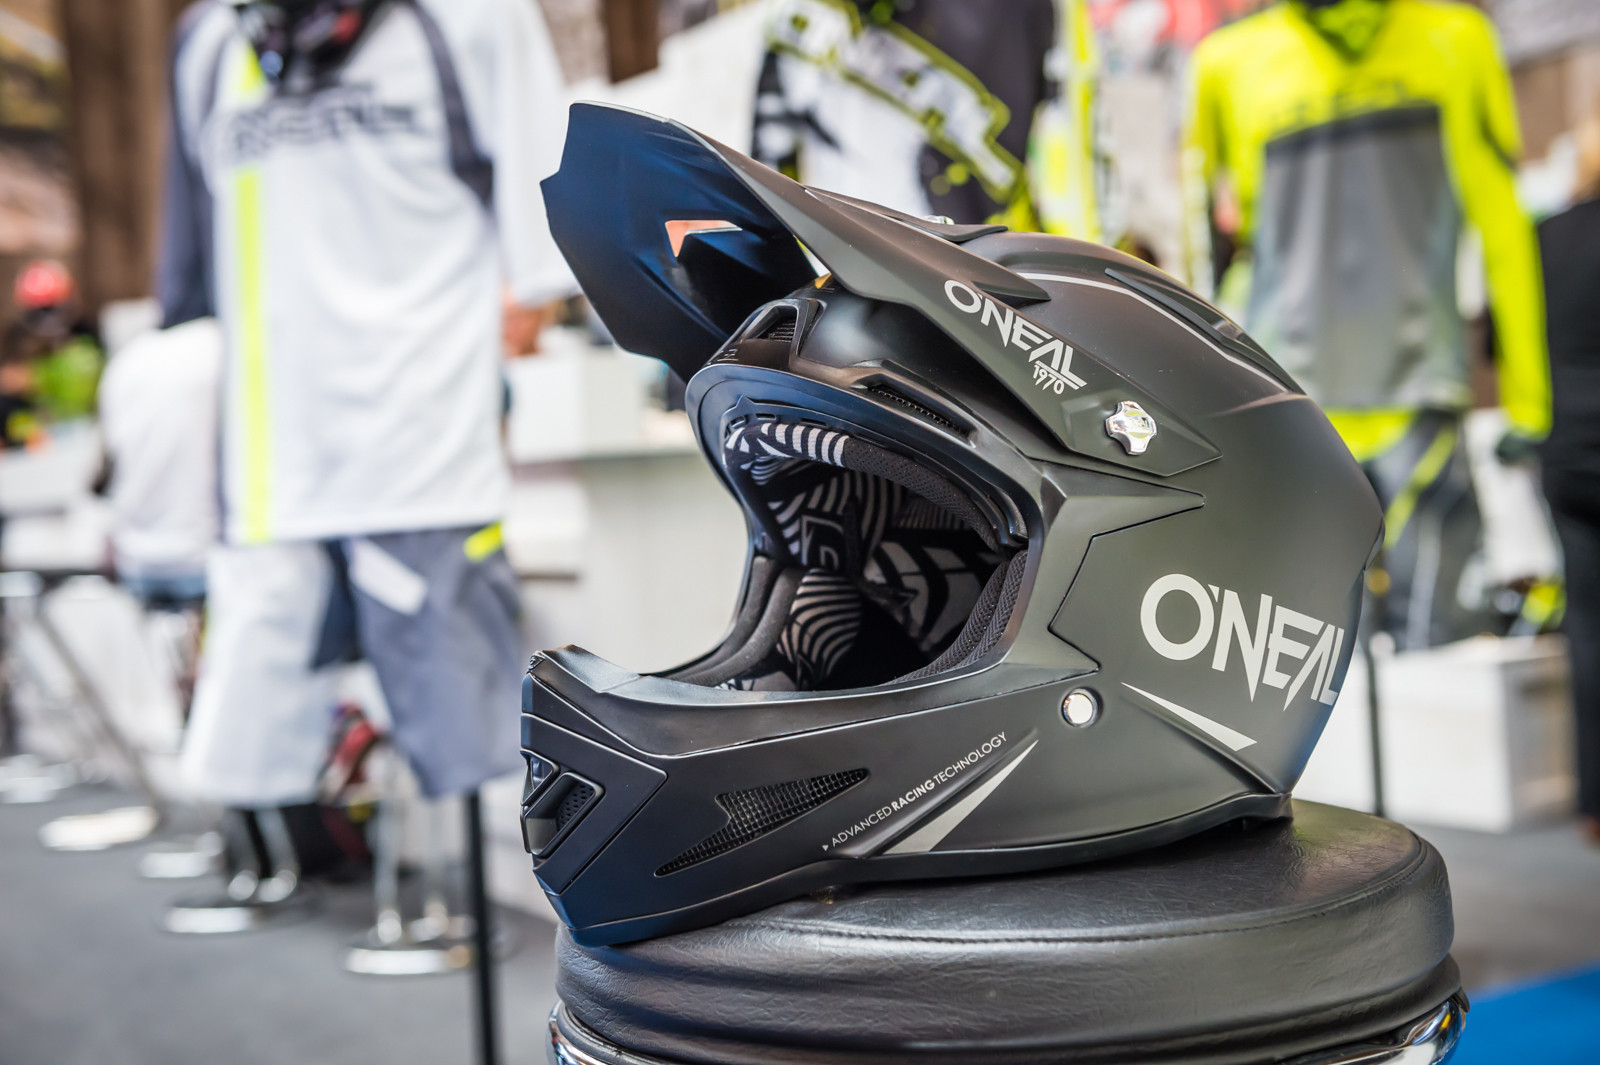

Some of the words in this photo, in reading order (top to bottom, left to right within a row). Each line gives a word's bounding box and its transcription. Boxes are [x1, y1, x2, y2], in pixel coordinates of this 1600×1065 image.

[944, 280, 1088, 387] O'NEAL
[1033, 364, 1065, 395] 1970
[1140, 573, 1345, 711] O'NEAL
[832, 806, 893, 847] ADVANCED
[891, 780, 935, 811] RACING
[933, 731, 1007, 785] TECHNOLOGY
